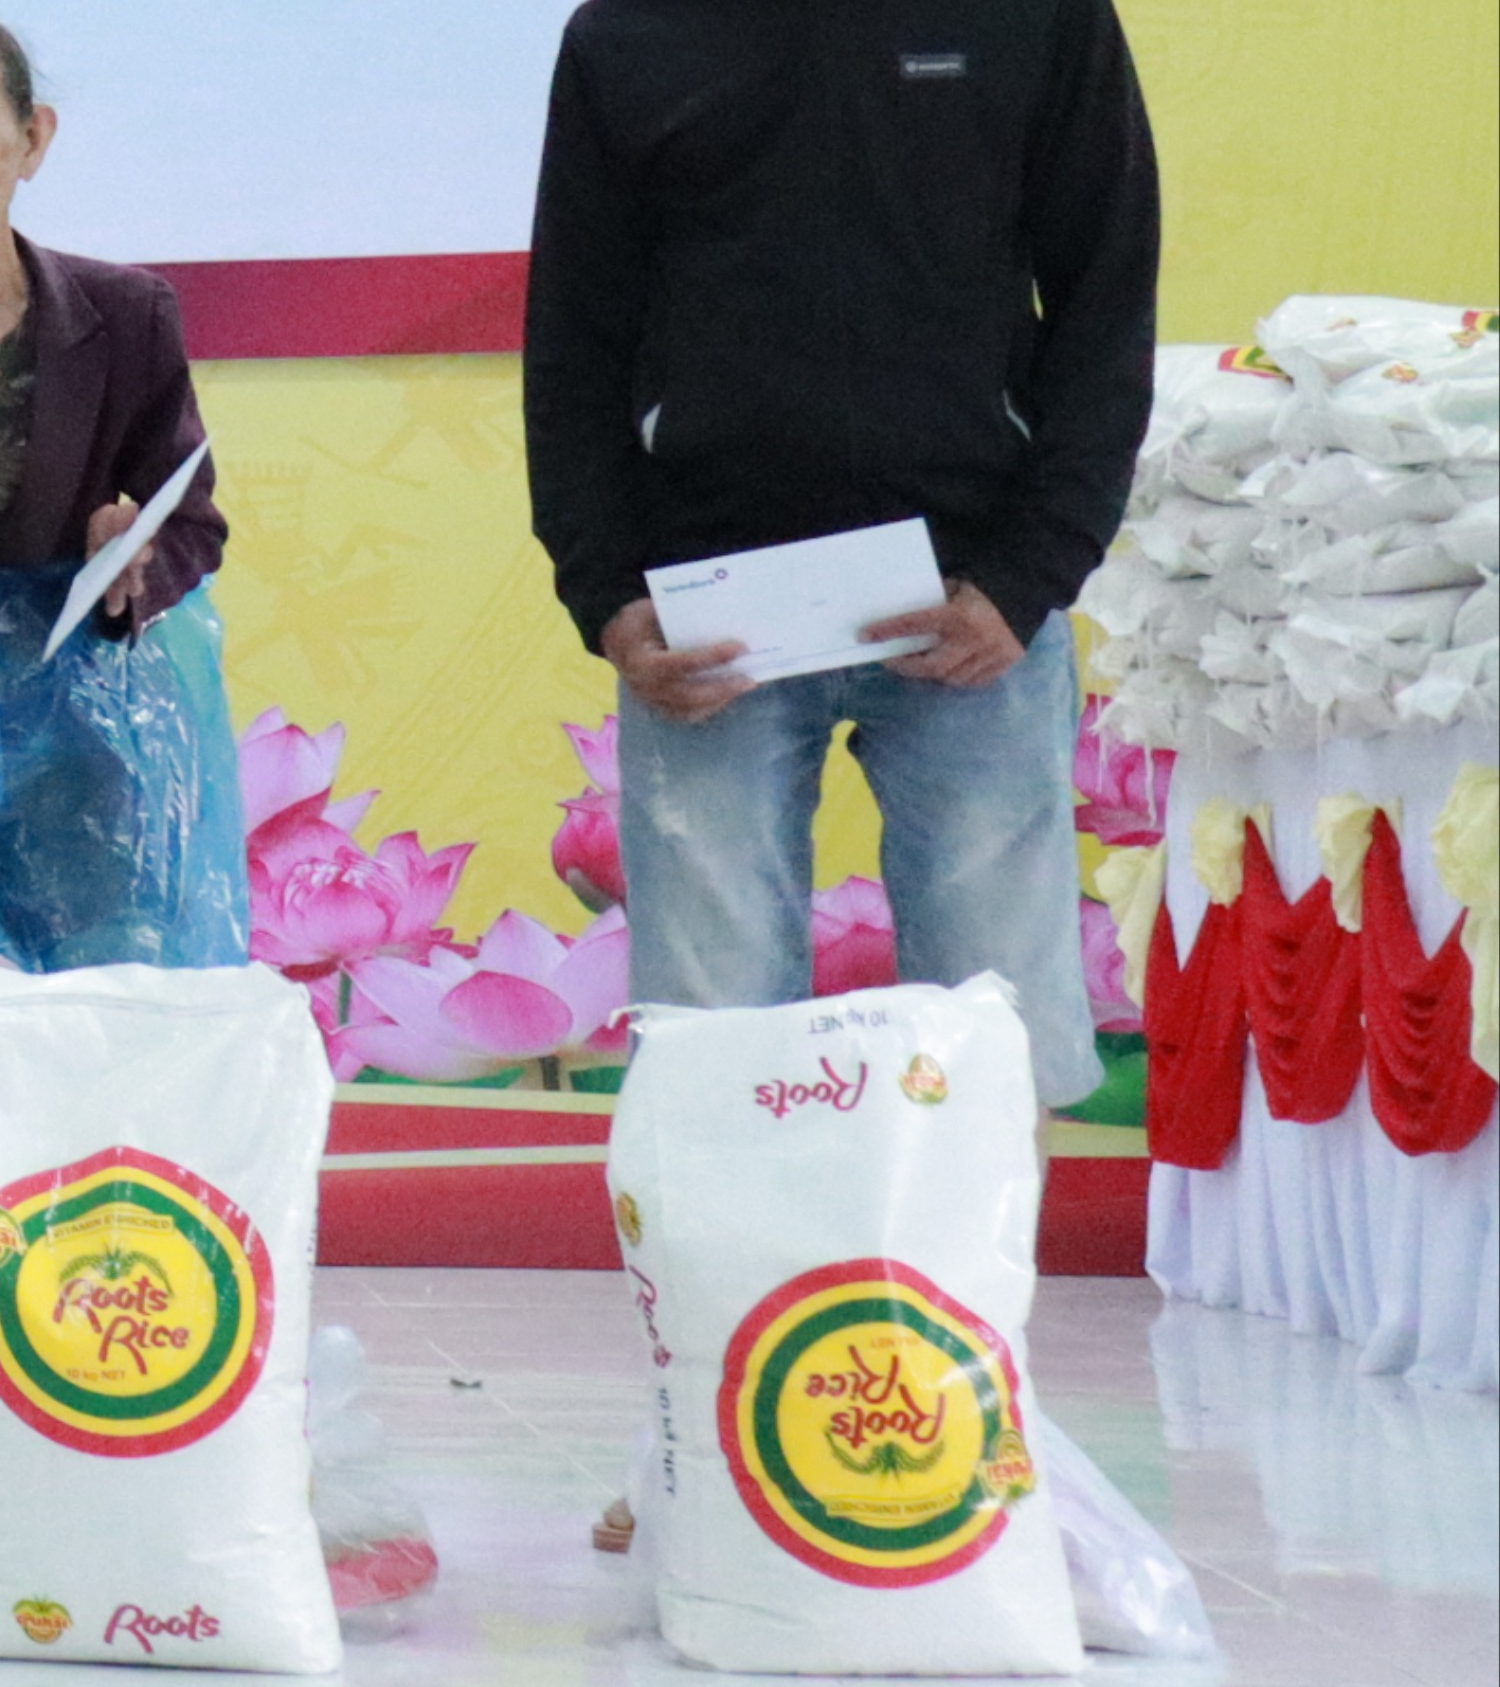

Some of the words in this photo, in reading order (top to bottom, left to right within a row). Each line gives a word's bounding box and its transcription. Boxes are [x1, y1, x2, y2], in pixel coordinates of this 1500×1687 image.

[755, 1057, 867, 1120] Roots
[53, 1276, 169, 1334] Roots
[99, 1315, 190, 1375] Rice
[101, 1369, 126, 1381] NET
[804, 1345, 900, 1406] Rice
[829, 1384, 947, 1450] Roots
[104, 1604, 220, 1654] Roots
